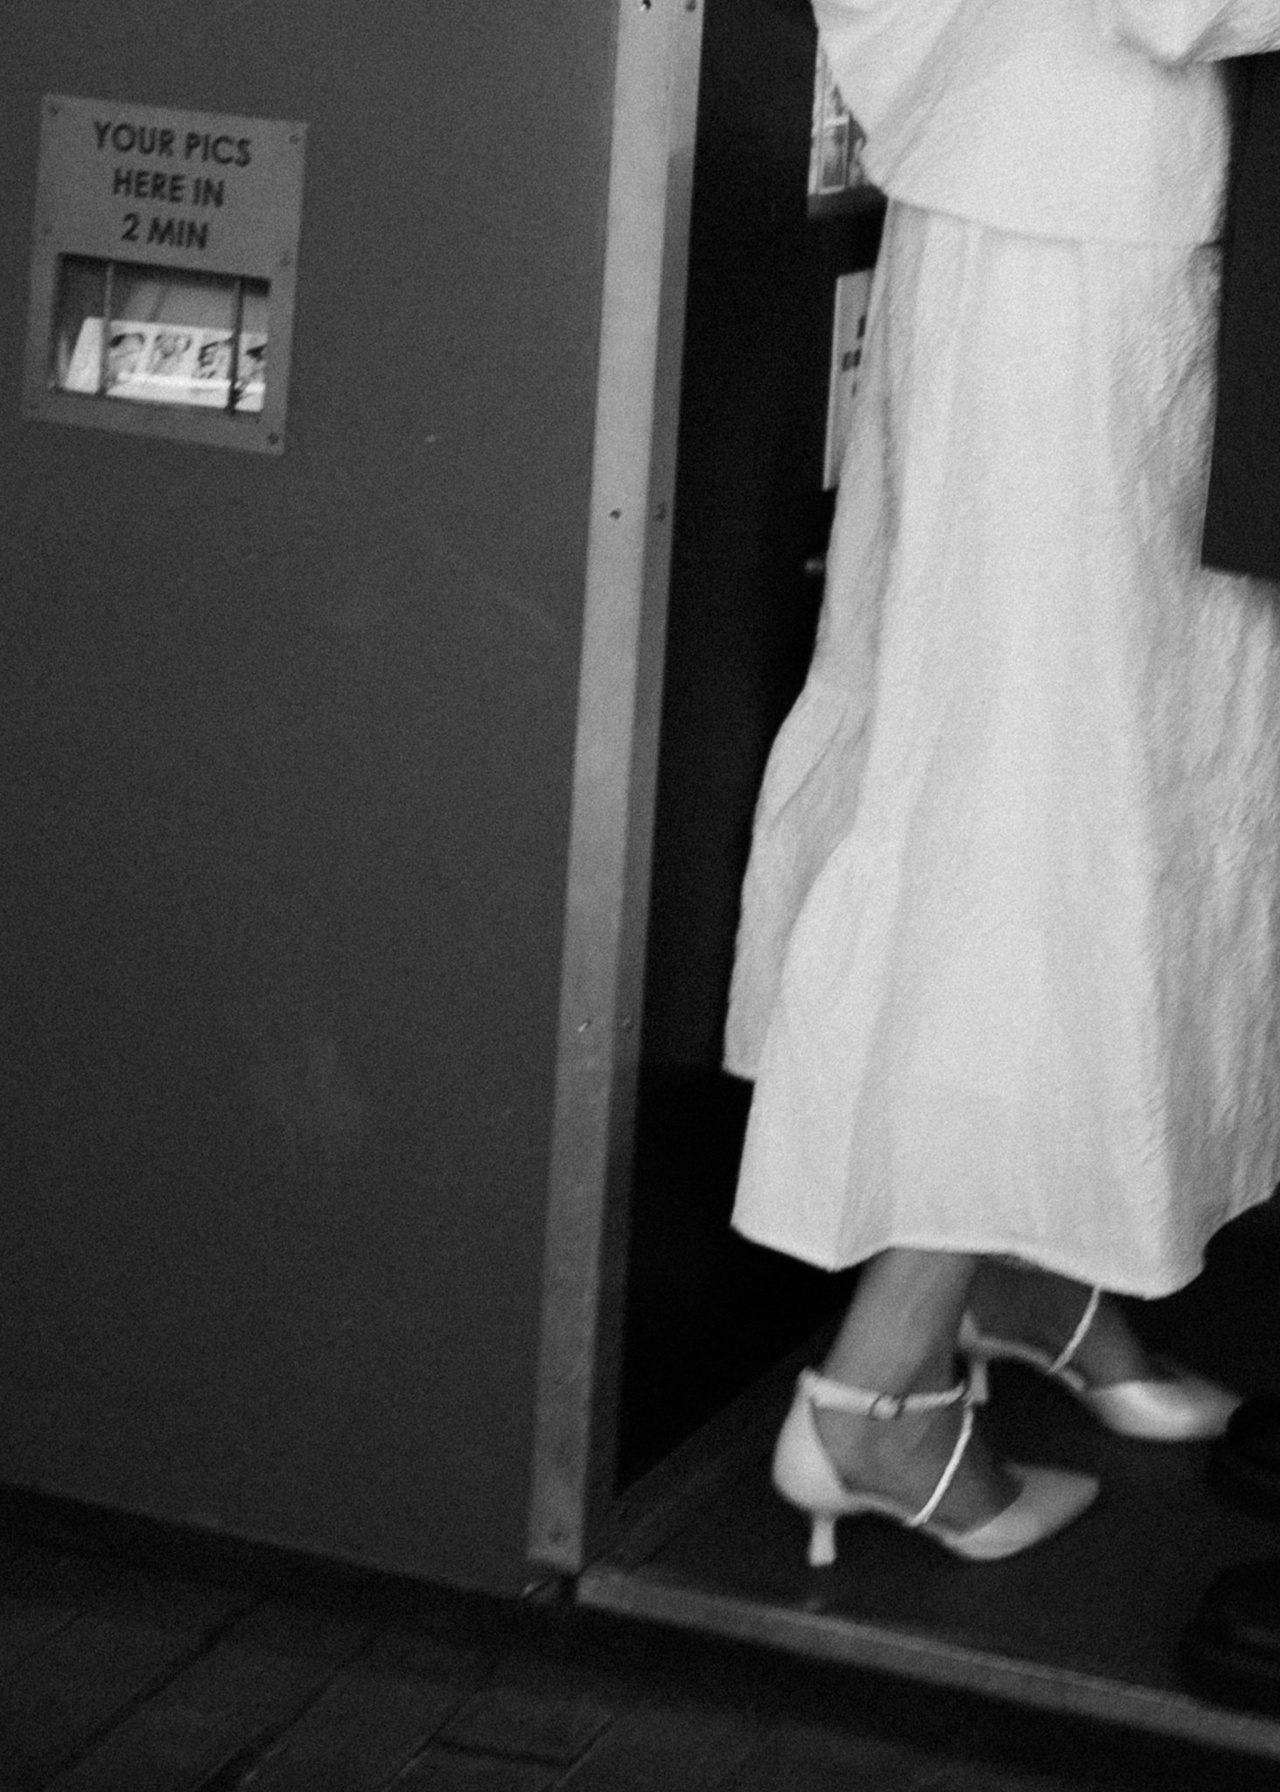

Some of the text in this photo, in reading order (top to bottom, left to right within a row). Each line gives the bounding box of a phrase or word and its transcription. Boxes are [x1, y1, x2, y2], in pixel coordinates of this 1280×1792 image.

[93, 120, 252, 168] YOUR PICS
[112, 168, 226, 209] HERE IN
[120, 211, 210, 250] 2 MIN
